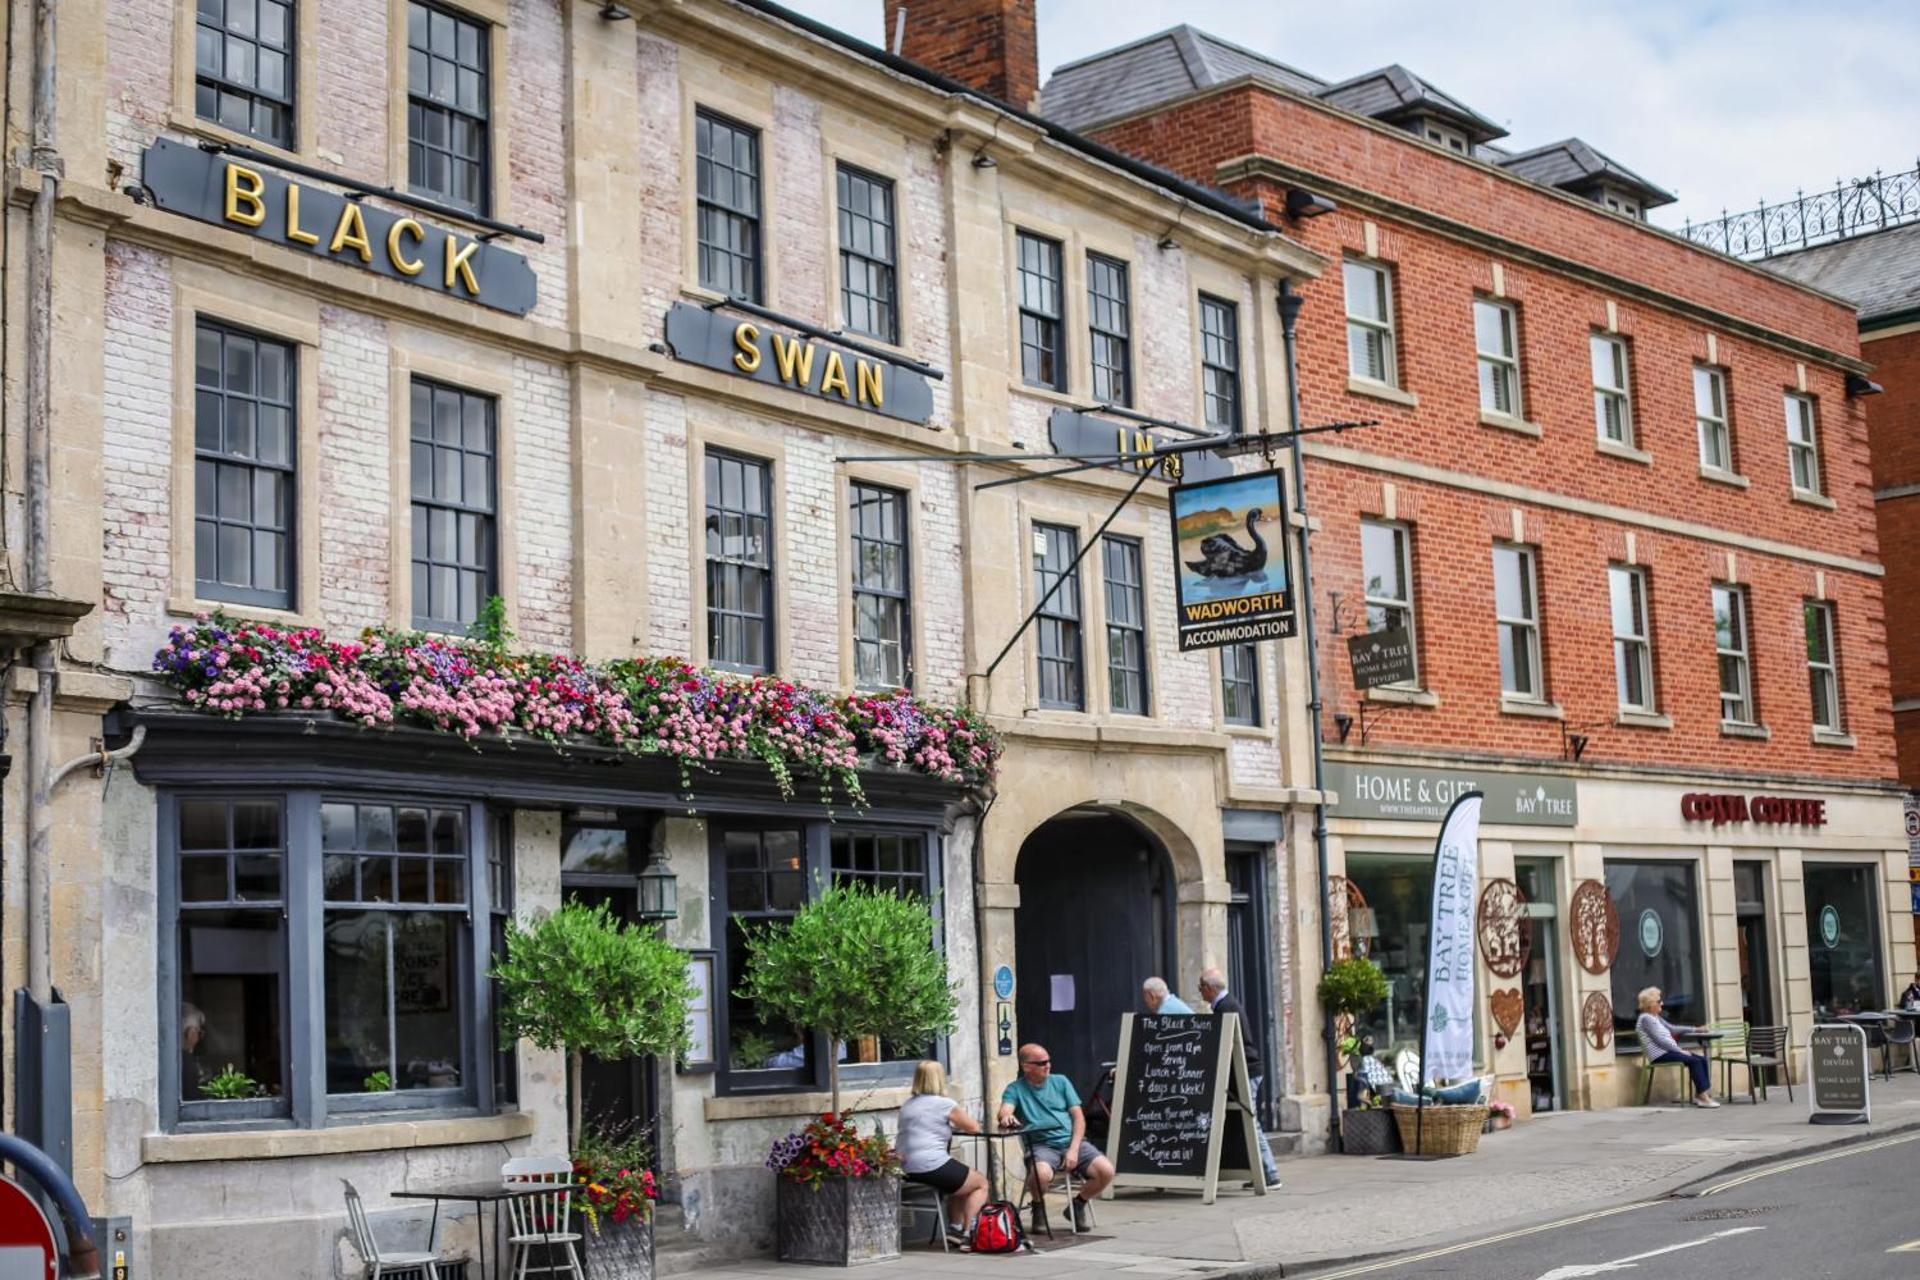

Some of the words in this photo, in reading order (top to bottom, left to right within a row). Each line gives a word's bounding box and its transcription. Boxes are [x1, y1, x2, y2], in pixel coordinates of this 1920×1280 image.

[225, 163, 480, 295] BLACK
[735, 323, 883, 407] SWAN
[1186, 594, 1284, 621] WADWORTH
[1185, 621, 1289, 647] ACCOMMODATION
[1352, 651, 1371, 664] BAY
[1382, 645, 1408, 659] TREE
[1357, 664, 1380, 674] HOME
[1355, 775, 1411, 801] HOME
[1417, 780, 1432, 803] &
[1516, 797, 1536, 814] BAY
[1546, 798, 1572, 815] TREE
[1681, 793, 1749, 826] COSTA
[1751, 796, 1827, 825] COFFEE
[1438, 844, 1459, 920] TREE
[1435, 929, 1453, 983] BAY
[1456, 922, 1470, 981] HOME
[1143, 1018, 1157, 1030] The
[1161, 1017, 1185, 1031] Black
[1190, 1017, 1211, 1030] Swan
[1144, 1043, 1162, 1055] Open
[1164, 1043, 1183, 1057] from
[1815, 1037, 1831, 1045] BAY
[1836, 1037, 1858, 1045] TREE
[1145, 1063, 1169, 1078] Lunch
[1177, 1068, 1205, 1079] Dinner
[1162, 1056, 1186, 1069] Serving
[1147, 1081, 1167, 1097] days
[1171, 1084, 1176, 1093] a
[1149, 1147, 1170, 1160] Come
